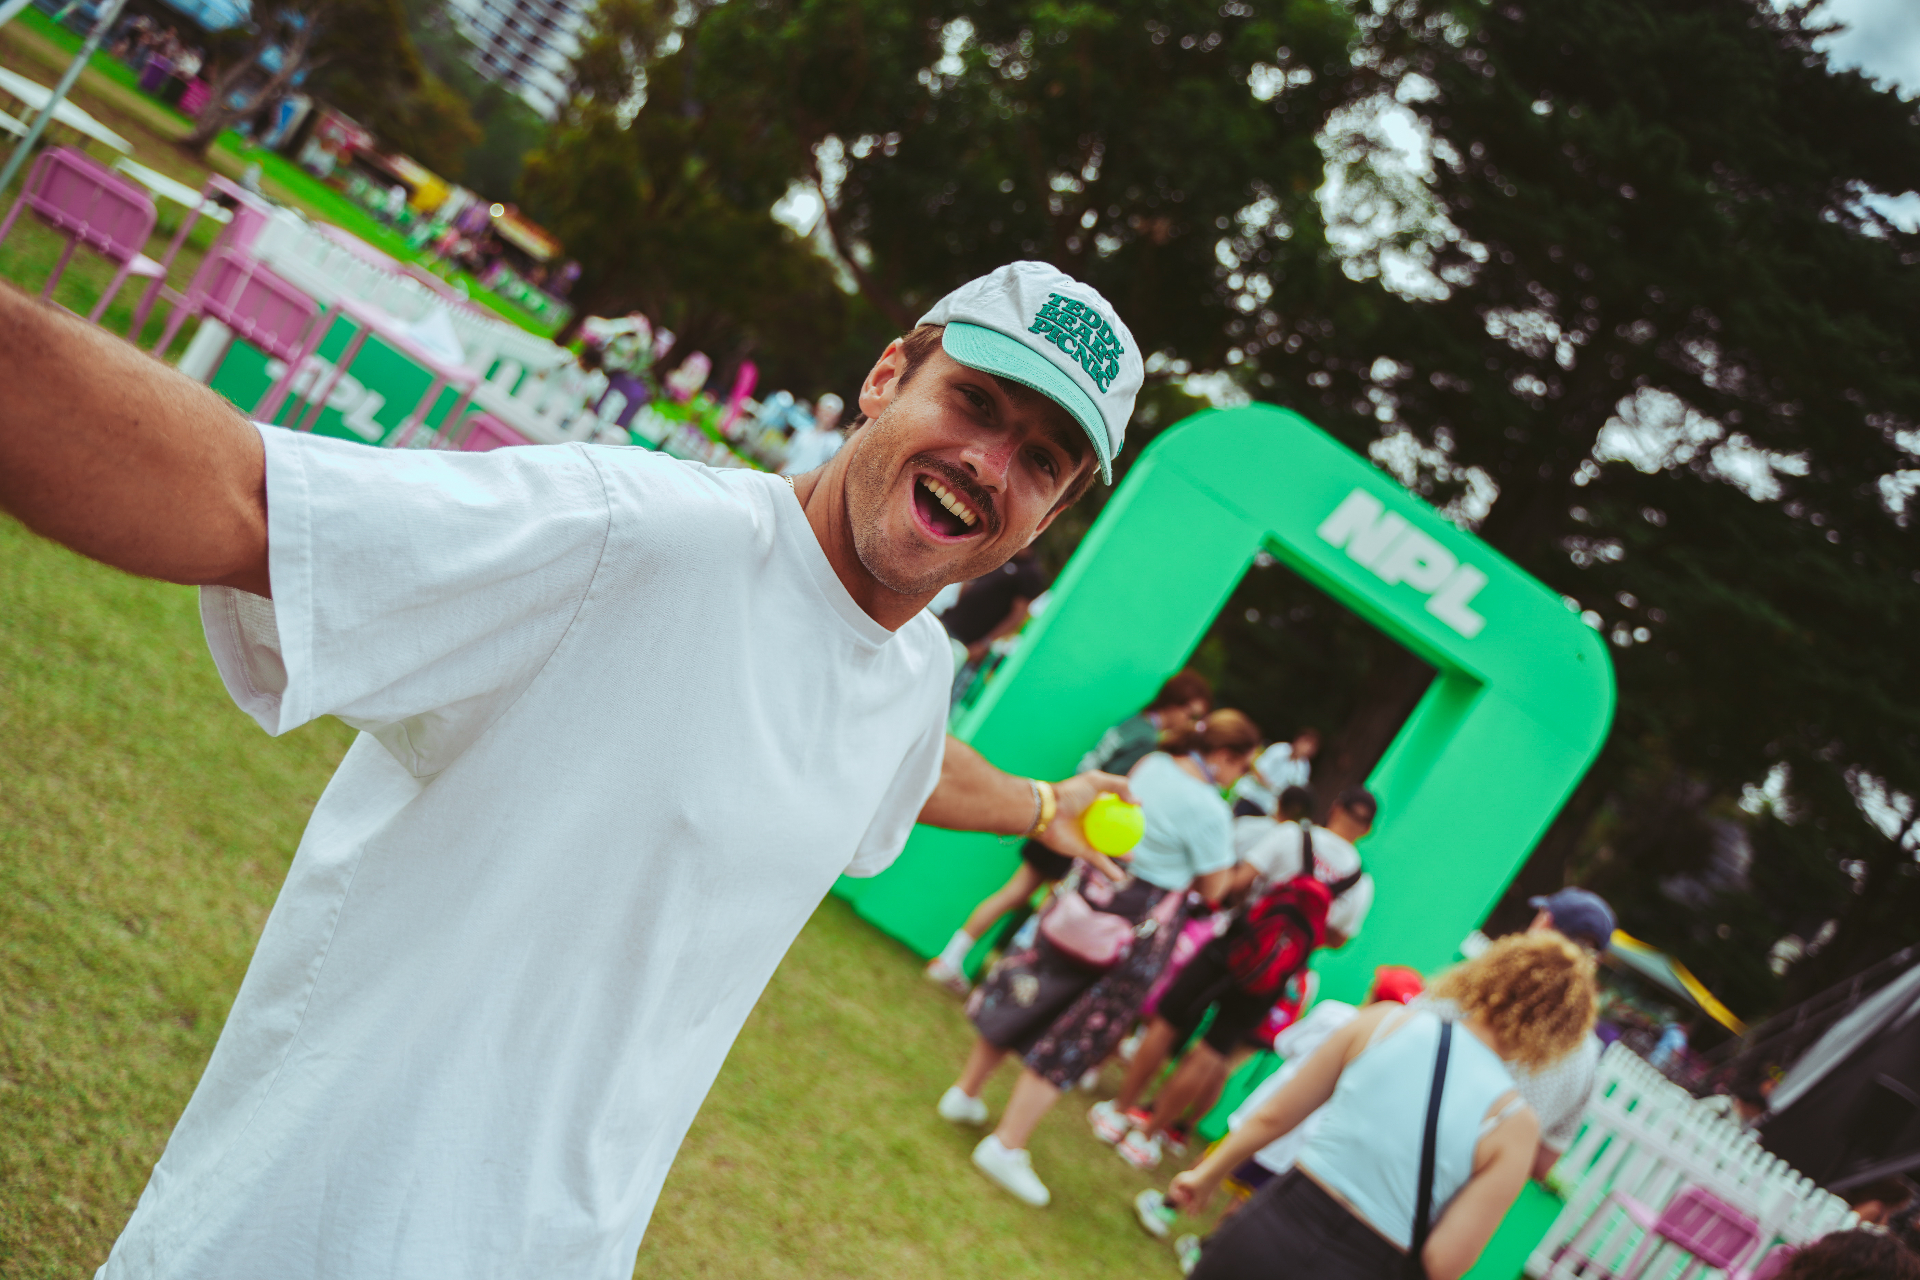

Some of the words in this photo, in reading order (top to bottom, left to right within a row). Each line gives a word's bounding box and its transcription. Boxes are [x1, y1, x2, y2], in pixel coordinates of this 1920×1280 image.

[1028, 317, 1110, 394] PICNIC
[1036, 304, 1120, 380] BEAR'S
[1049, 293, 1124, 359] TEDDY
[1316, 487, 1490, 640] NPL
